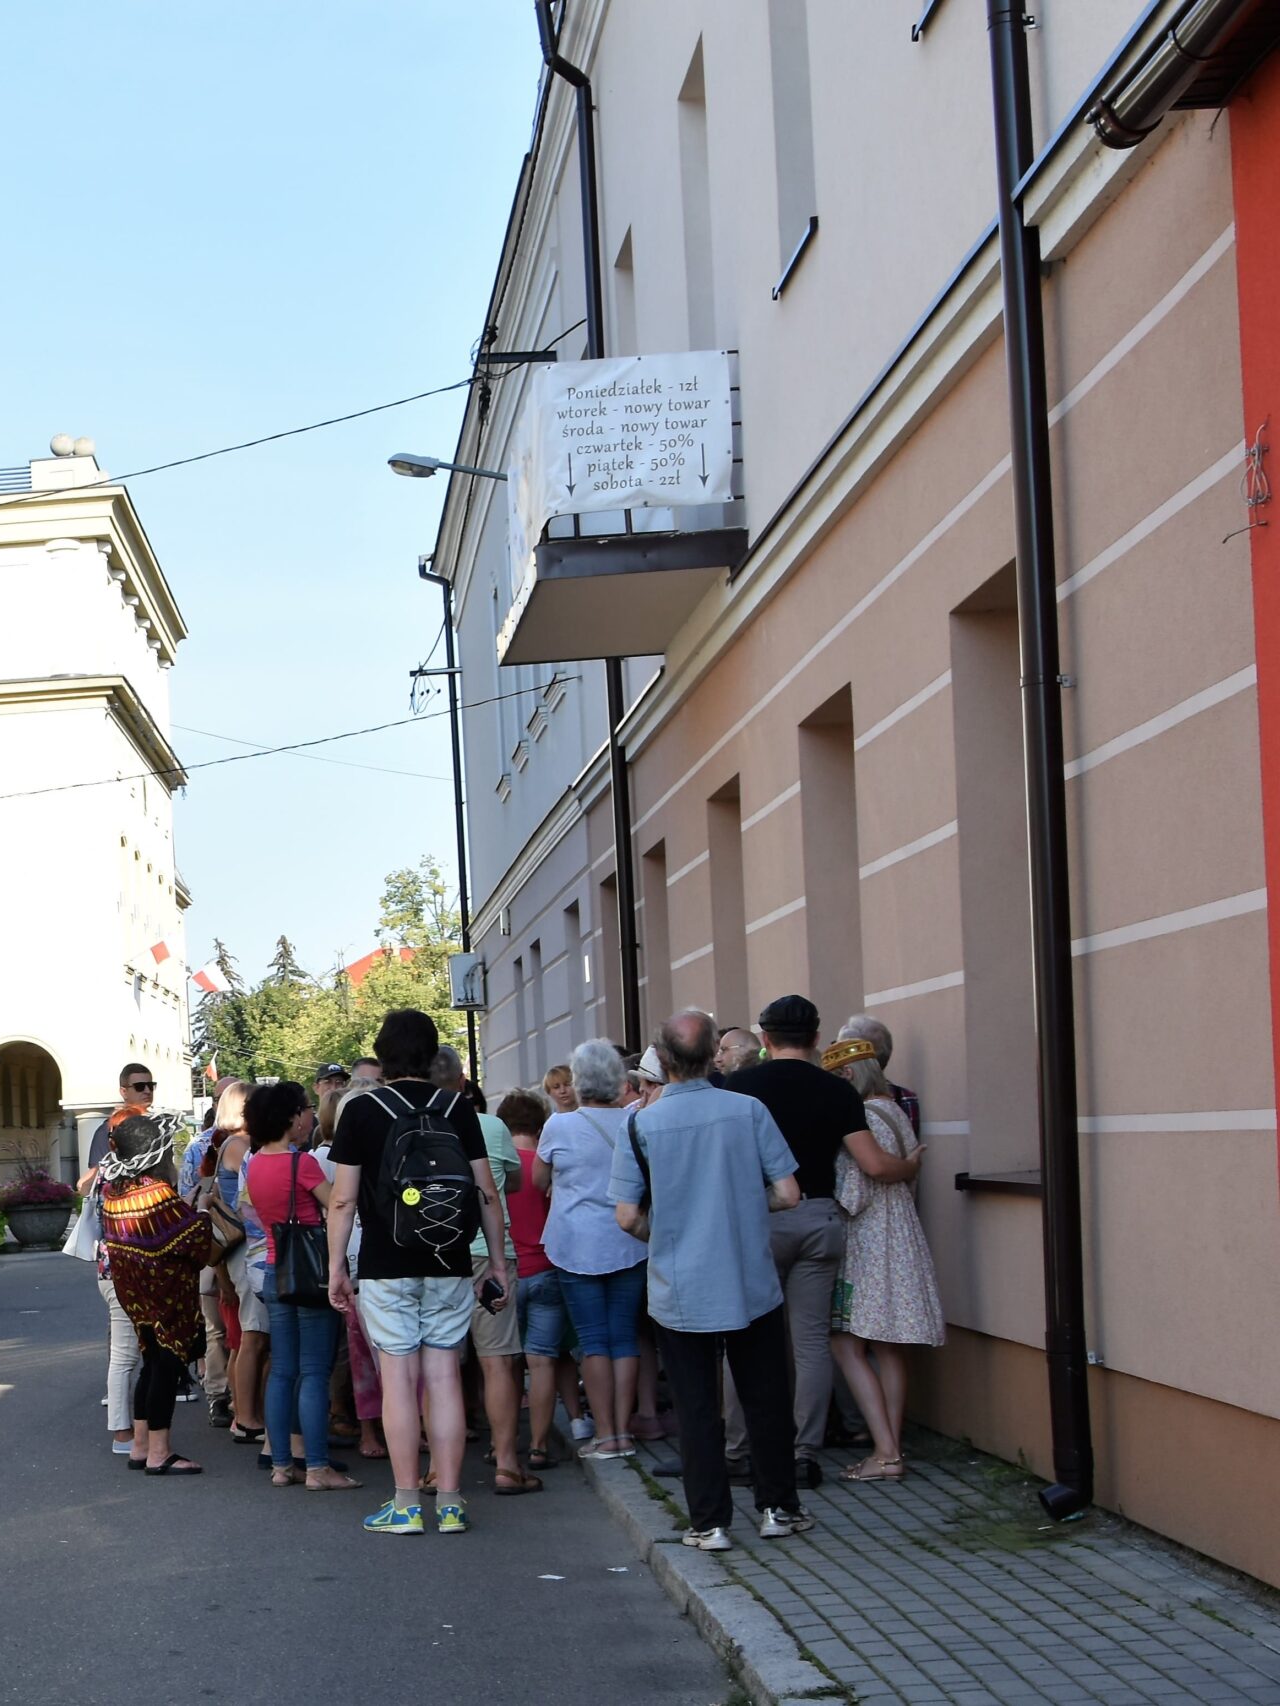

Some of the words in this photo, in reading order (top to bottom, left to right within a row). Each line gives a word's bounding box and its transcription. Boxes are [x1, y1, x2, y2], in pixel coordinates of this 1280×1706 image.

[567, 378, 662, 400] Poniedziałek
[680, 375, 698, 392] 1zł
[557, 400, 608, 420] wtorek
[624, 402, 663, 418] nowy
[668, 398, 711, 412] towar
[562, 420, 604, 438] środa
[621, 421, 660, 436] nowy
[665, 417, 708, 430] towar
[576, 435, 643, 455] czwartek
[659, 433, 695, 453] 50%
[587, 454, 635, 478] piątek
[650, 452, 686, 471] 50%
[593, 473, 644, 491] sobota
[659, 469, 681, 486] 2zł
